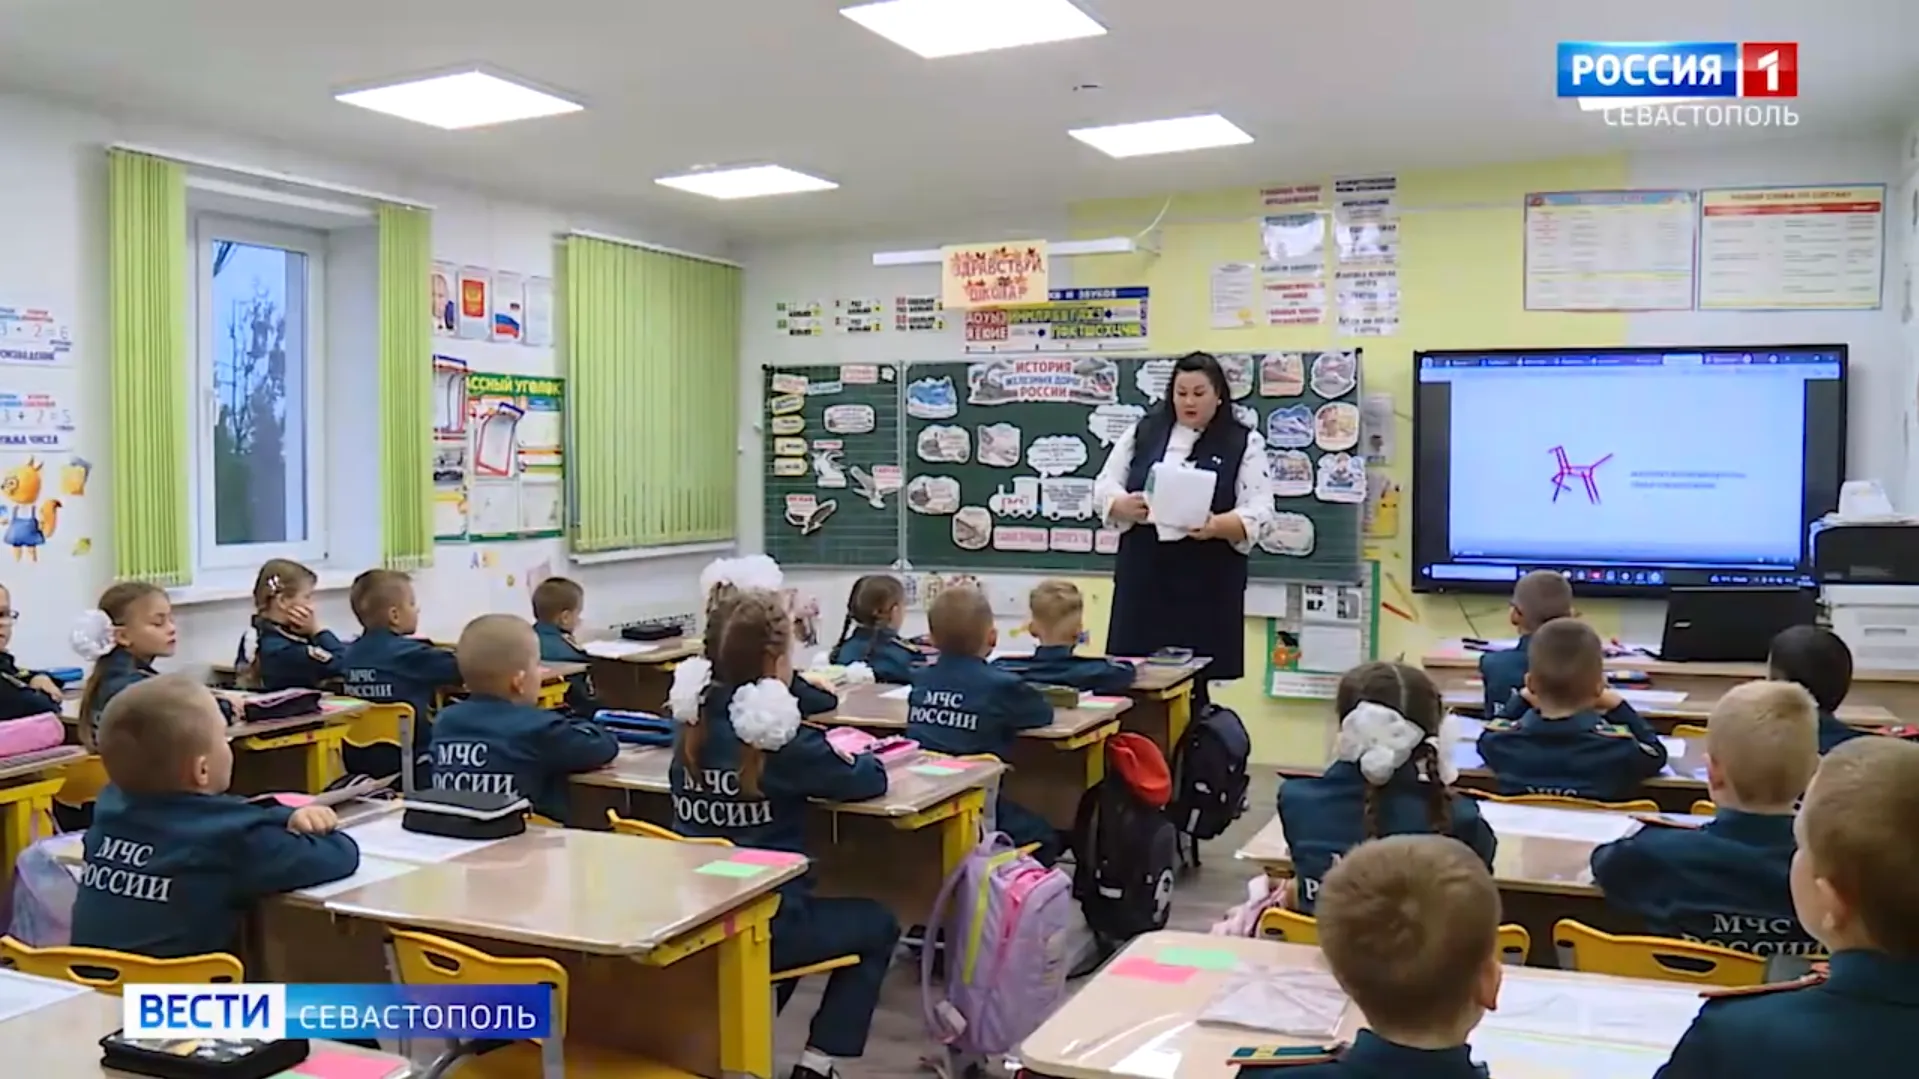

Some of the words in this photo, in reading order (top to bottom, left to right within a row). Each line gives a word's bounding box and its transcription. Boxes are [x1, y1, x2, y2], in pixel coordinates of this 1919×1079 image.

[1015, 361, 1072, 374] ИСТОРИЯ
[1020, 386, 1067, 398] РОССИИ
[349, 668, 377, 683] МЧС
[923, 689, 964, 709] МЧС
[910, 705, 979, 730] РОССИИ
[437, 742, 489, 768] МЧС
[432, 771, 514, 796] ОССИИ
[682, 765, 740, 796] МЧС
[94, 836, 154, 867] МЧС
[1712, 913, 1792, 934] МЧС
